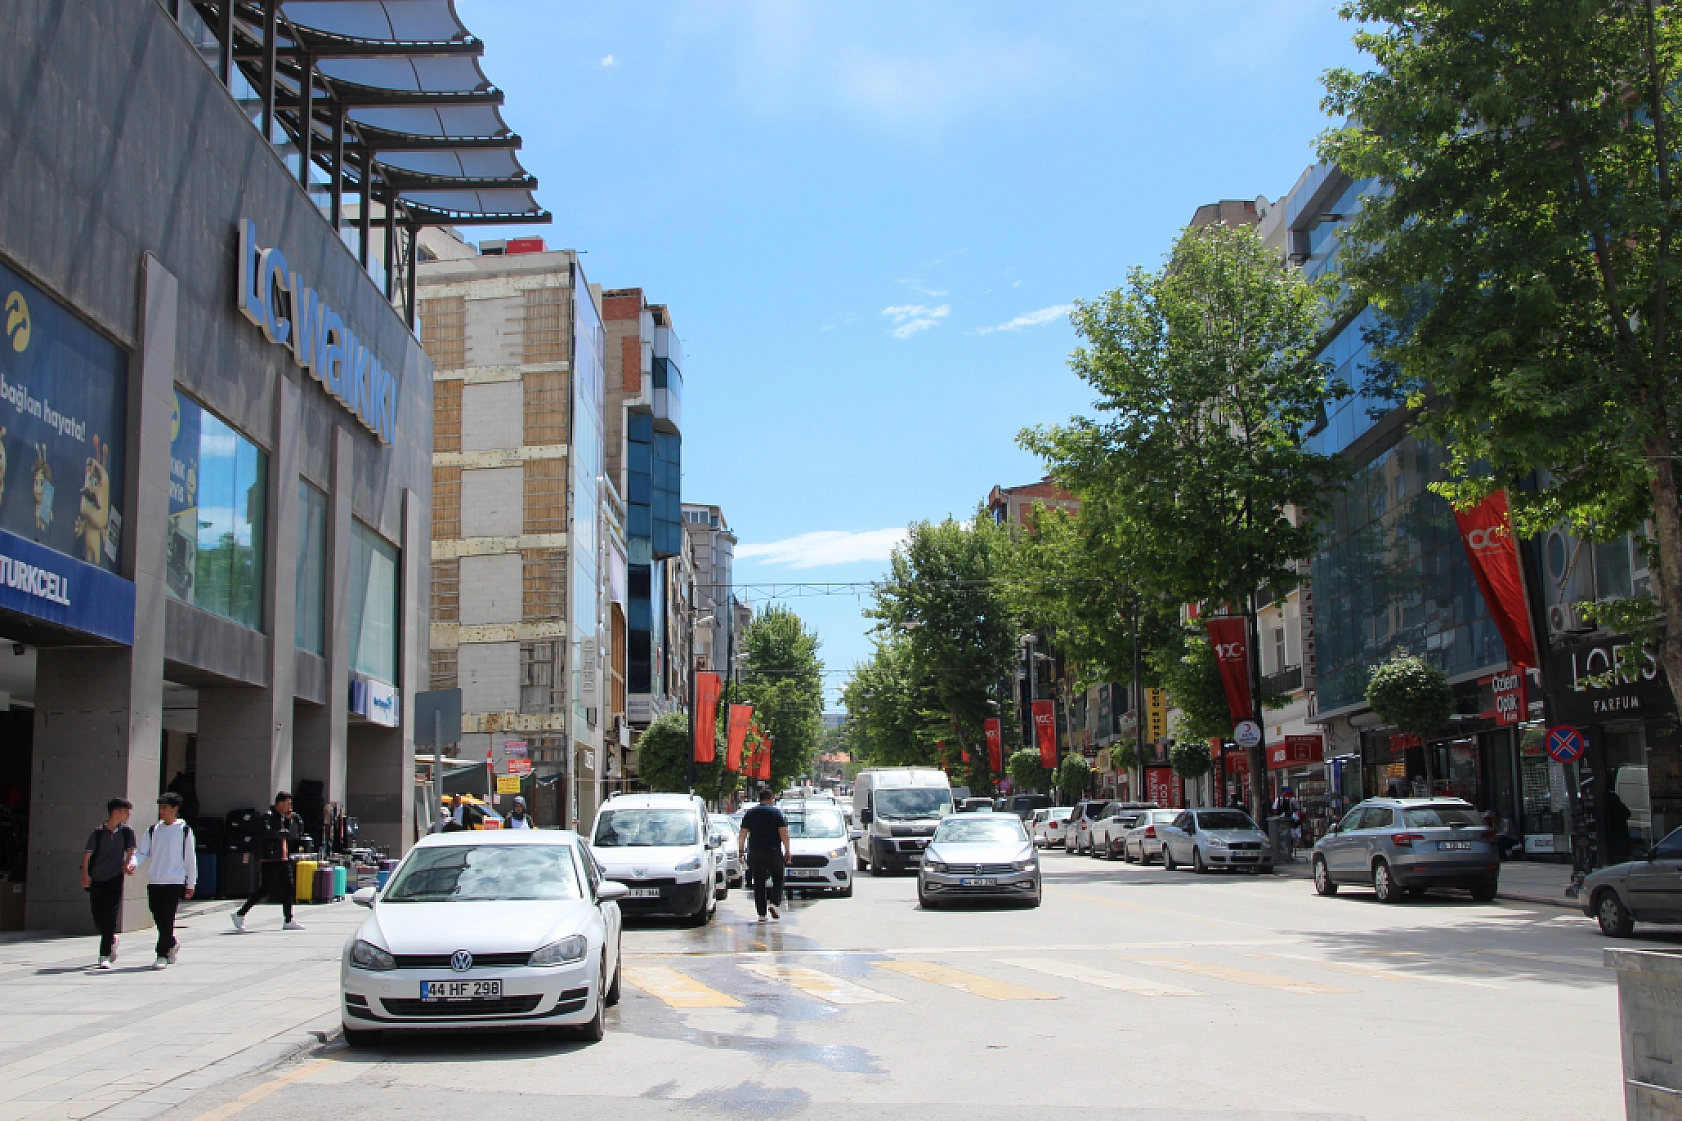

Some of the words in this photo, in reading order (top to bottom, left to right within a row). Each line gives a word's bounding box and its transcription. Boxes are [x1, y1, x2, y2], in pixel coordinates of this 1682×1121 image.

[238, 218, 291, 344] LC
[1, 373, 42, 419] bağlan
[44, 398, 86, 443] hayata!
[0, 554, 70, 606] TURKCELL
[1593, 696, 1640, 713] PARFUM
[429, 983, 446, 996] 44
[449, 983, 470, 996] HF
[473, 982, 499, 996] 298
